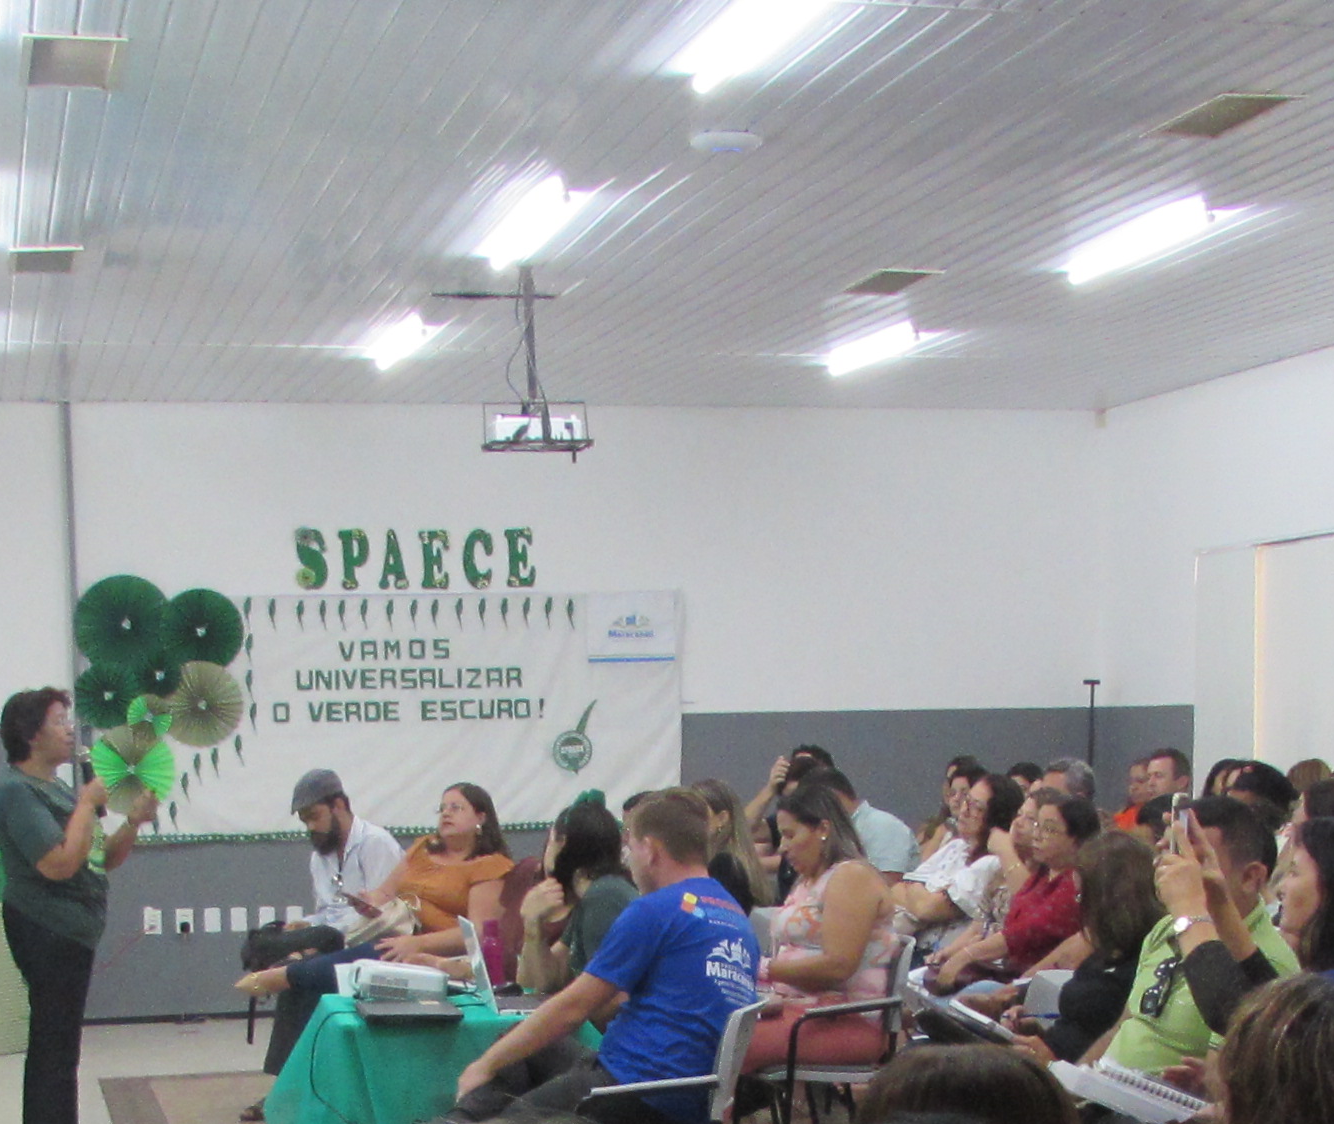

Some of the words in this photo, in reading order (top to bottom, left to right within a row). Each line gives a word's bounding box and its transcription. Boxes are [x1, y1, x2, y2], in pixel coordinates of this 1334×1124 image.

[295, 527, 536, 590] SPAECE
[339, 638, 450, 661] VAMOS
[296, 667, 523, 691] UNIVERSALIZAR
[272, 701, 291, 723] O
[308, 700, 400, 723] VERDE
[420, 697, 545, 721] ESCURO!
